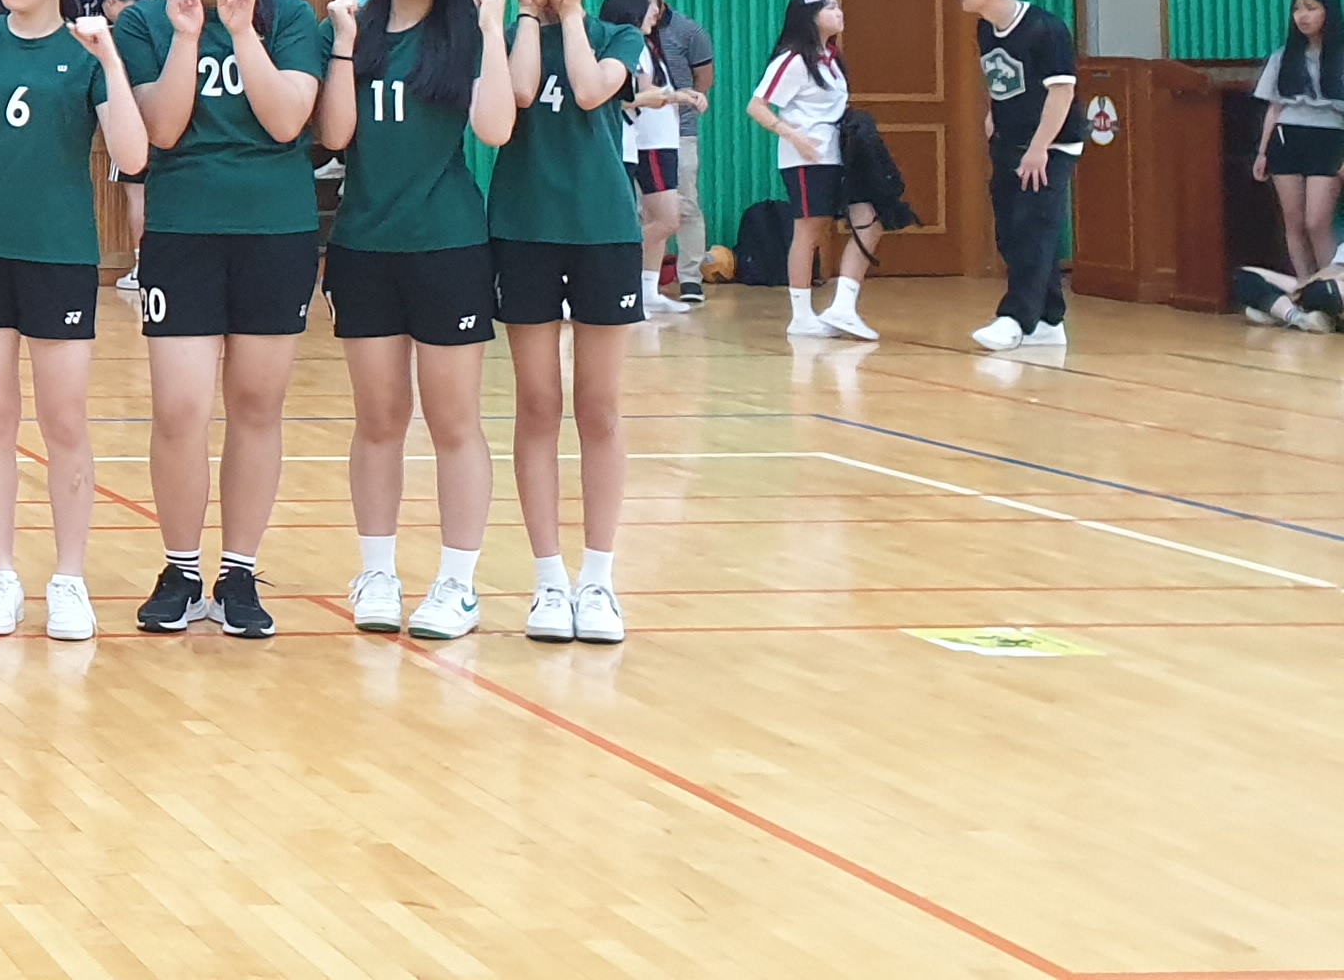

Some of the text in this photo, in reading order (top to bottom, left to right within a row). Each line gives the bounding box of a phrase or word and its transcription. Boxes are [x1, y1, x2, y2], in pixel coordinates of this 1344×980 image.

[197, 54, 246, 97] 20
[5, 86, 31, 128] 6
[370, 79, 405, 122] 11
